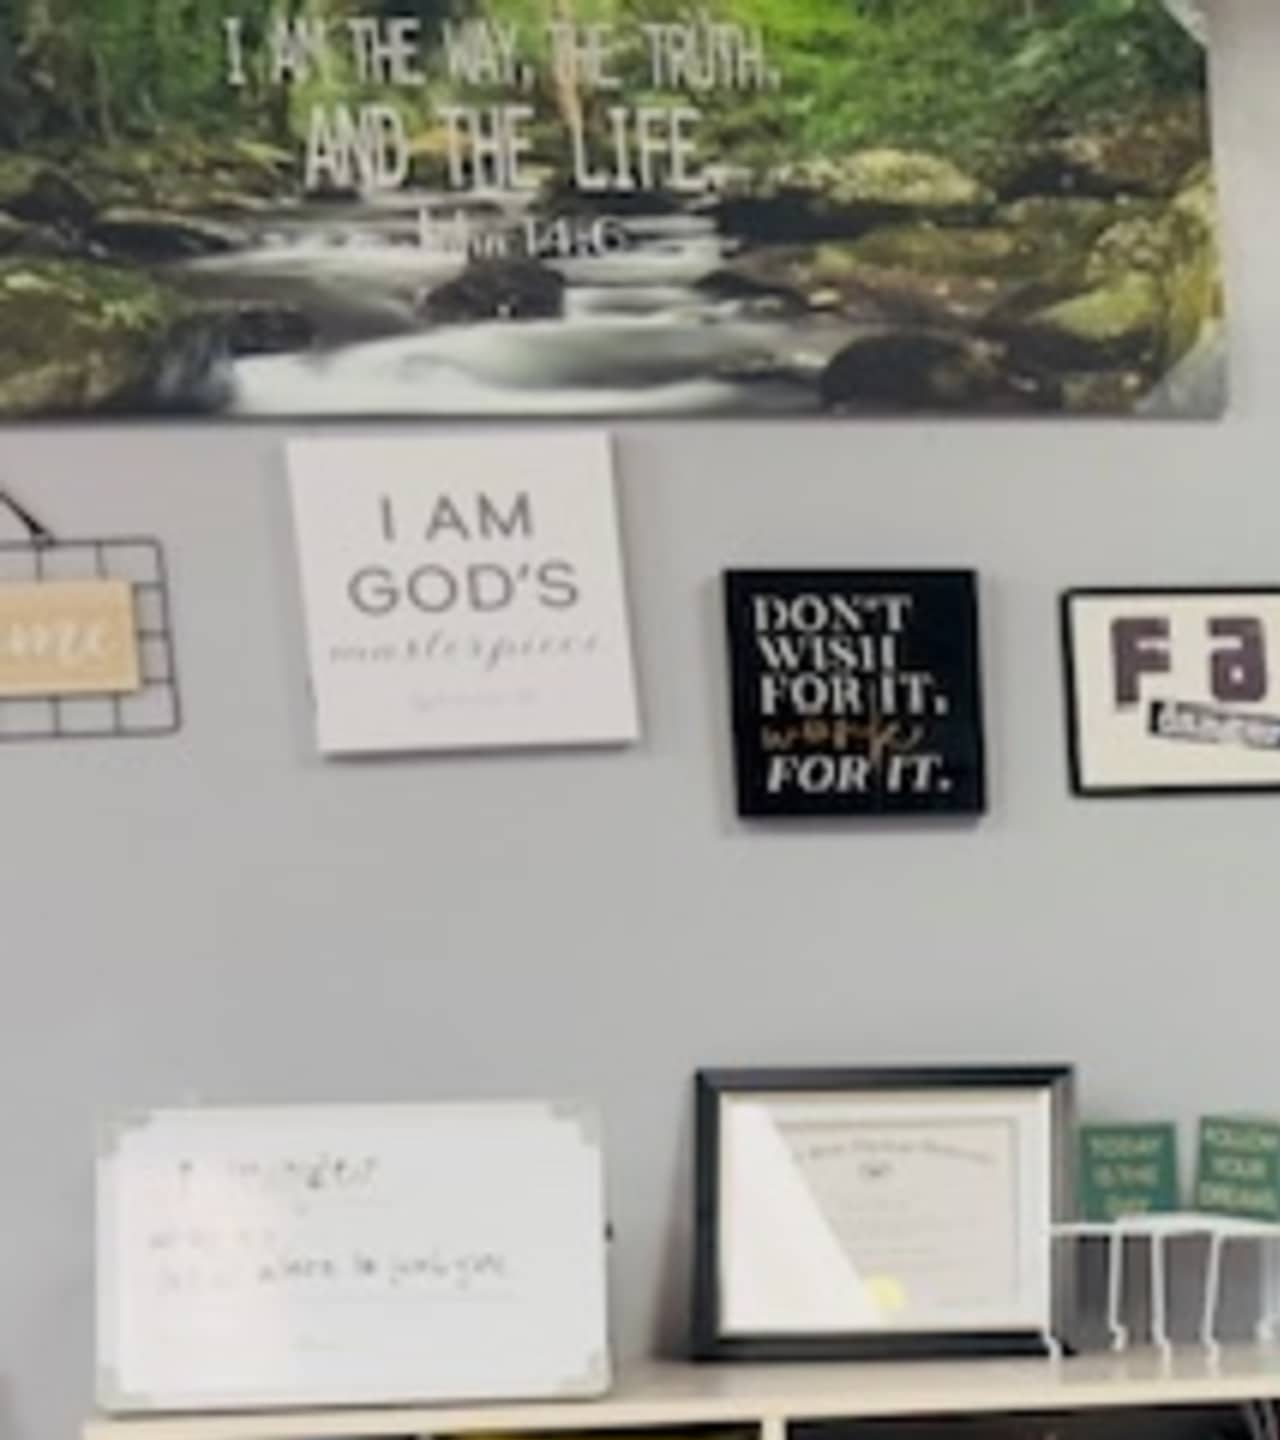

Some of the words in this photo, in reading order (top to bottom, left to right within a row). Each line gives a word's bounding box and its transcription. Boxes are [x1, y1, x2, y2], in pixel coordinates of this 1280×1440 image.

[223, 16, 247, 86] I
[268, 17, 328, 84] AM
[346, 17, 425, 86] THE
[546, 22, 622, 89] THE
[304, 106, 410, 190] AND
[437, 106, 548, 190] THE
[378, 494, 396, 542] I
[425, 491, 534, 541] AM
[348, 555, 580, 618] GOD'S
[754, 594, 912, 633] DON'T
[757, 634, 896, 673] WISH
[760, 675, 863, 716] FOR
[880, 674, 948, 715] IT.
[766, 755, 870, 794] FOR
[886, 754, 952, 793] IT.
